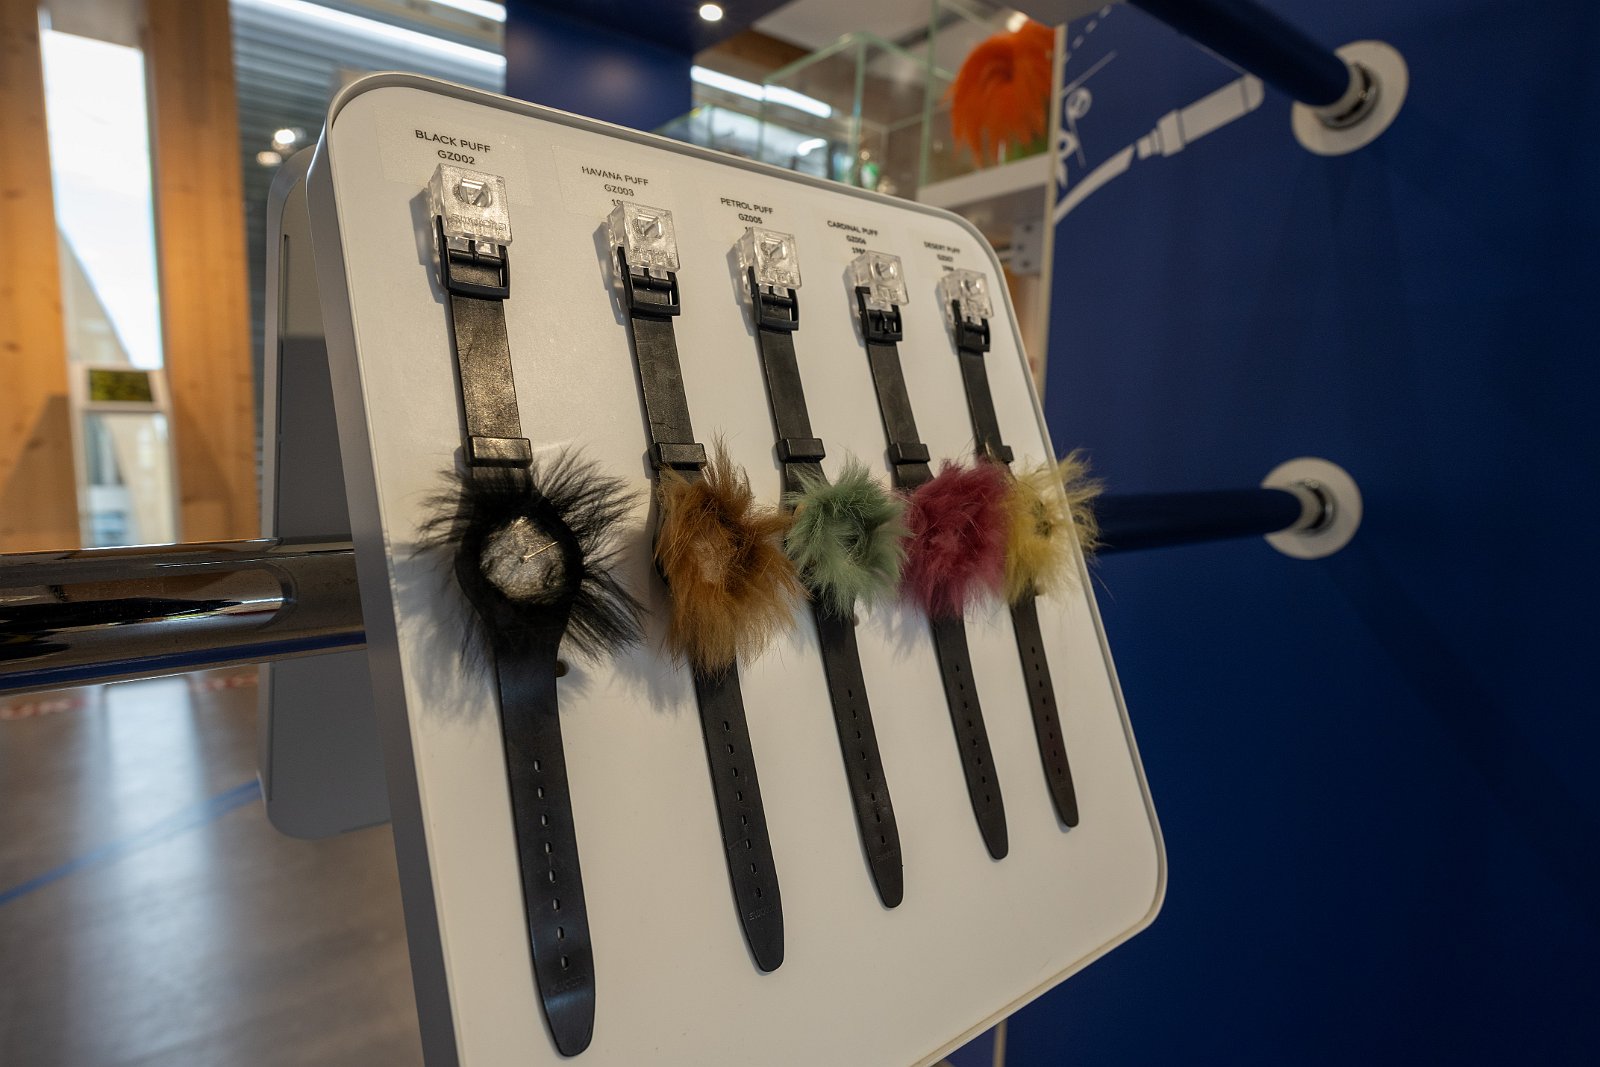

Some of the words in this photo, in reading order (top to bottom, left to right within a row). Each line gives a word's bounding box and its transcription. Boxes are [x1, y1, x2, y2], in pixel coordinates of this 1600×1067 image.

[415, 129, 457, 147] BLACK
[460, 140, 491, 153] PUFF
[437, 150, 476, 165] GZ002
[582, 166, 623, 181] HAVANA
[625, 174, 649, 186] PUFF
[604, 183, 635, 197] GZ003
[720, 197, 753, 211] PETROL
[753, 204, 773, 214] PUFF
[738, 213, 763, 224] GZ005
[827, 220, 861, 233] CARDINAL
[862, 227, 878, 236] PUFF
[923, 241, 946, 251] DESERT
[946, 245, 961, 253] PUFF
